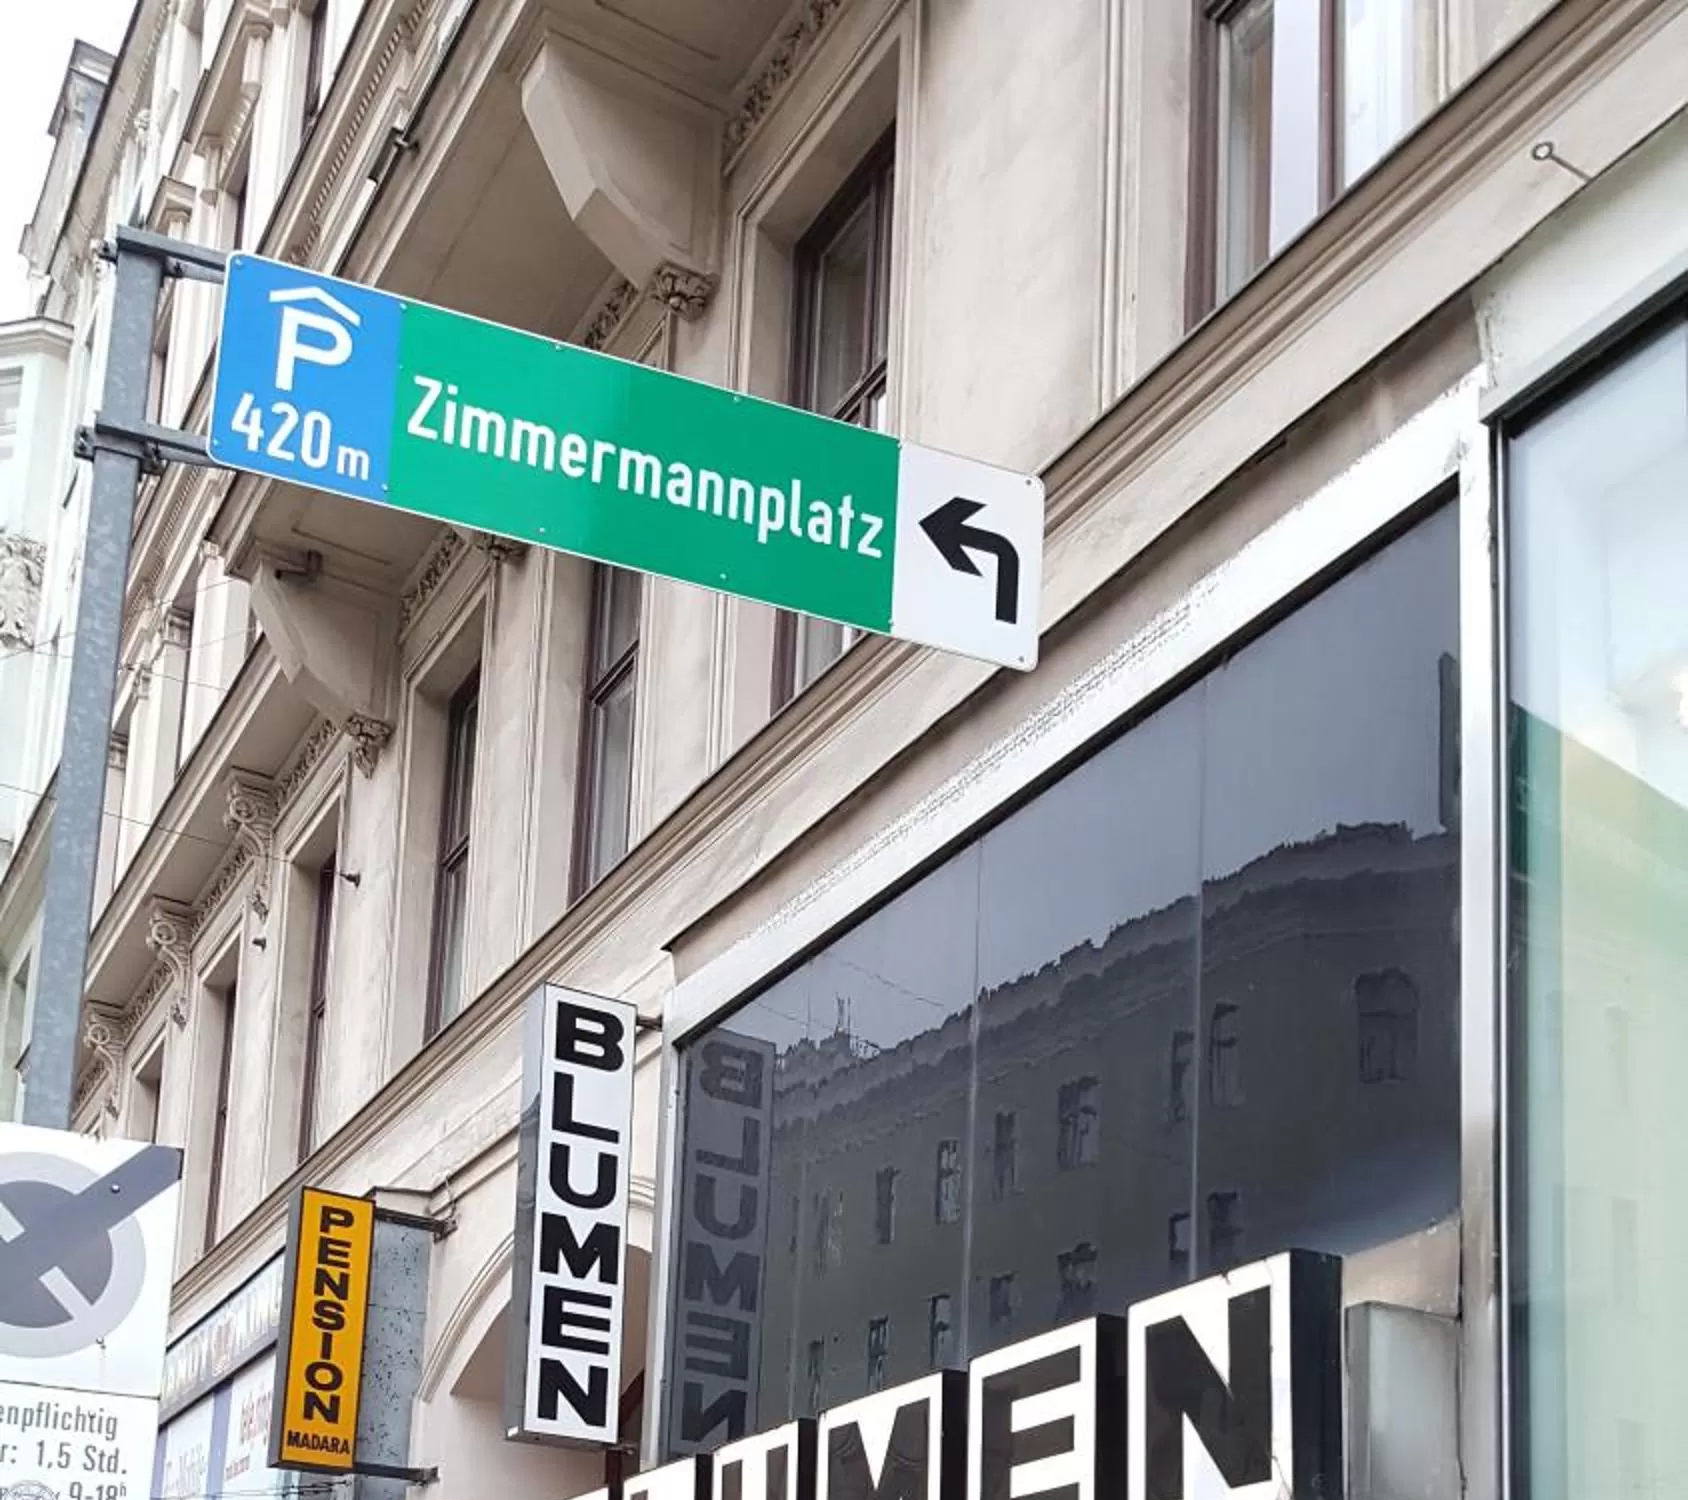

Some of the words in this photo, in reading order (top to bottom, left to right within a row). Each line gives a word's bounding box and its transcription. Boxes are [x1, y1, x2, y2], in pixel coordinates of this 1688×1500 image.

[275, 305, 354, 392] P
[406, 375, 884, 560] Zimmermannplatz
[535, 1000, 626, 1429] BLUMEN
[303, 1205, 354, 1424] PENSION
[37, 1440, 72, 1469] 1,5
[82, 1444, 127, 1475] Std.
[287, 1429, 351, 1455] MADARA
